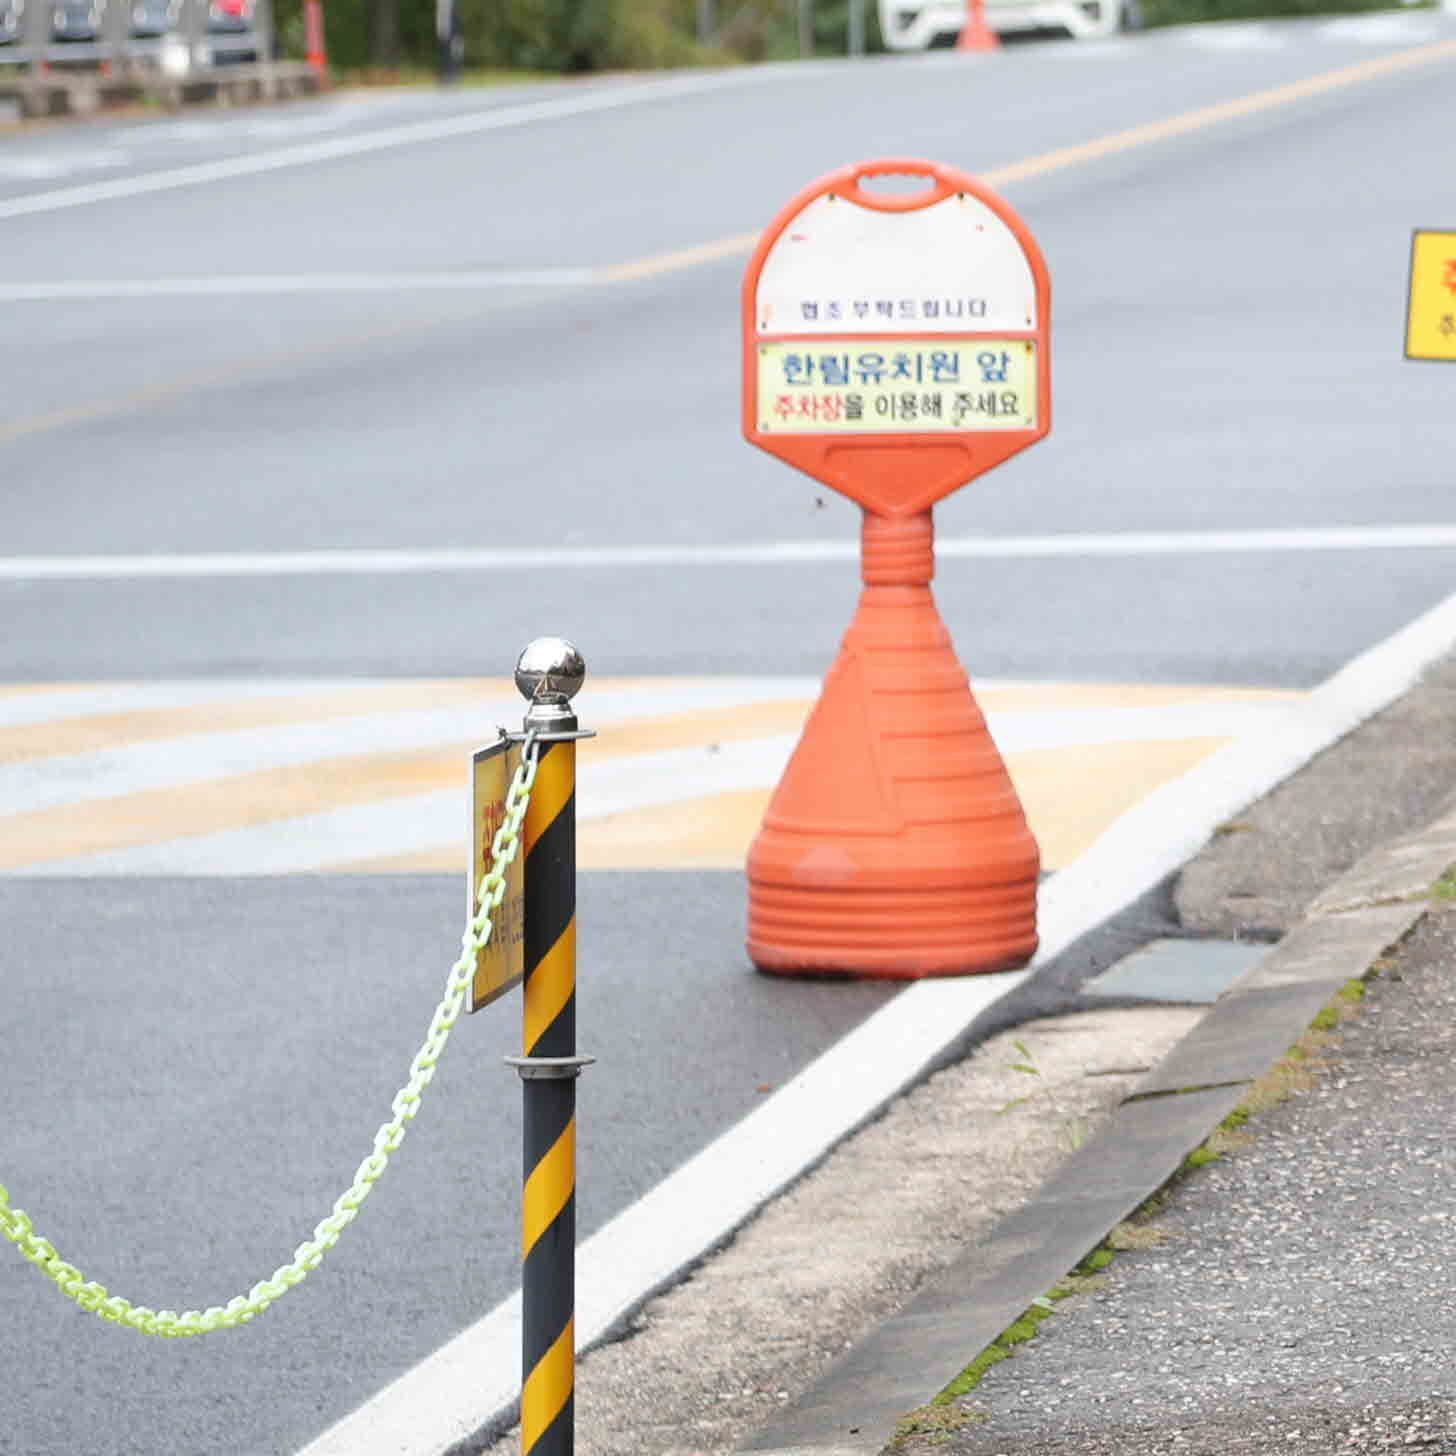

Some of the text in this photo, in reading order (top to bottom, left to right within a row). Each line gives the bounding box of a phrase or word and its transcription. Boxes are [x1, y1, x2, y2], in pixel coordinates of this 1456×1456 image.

[852, 299, 988, 320] 부탁드립니다
[782, 351, 1011, 386] 한림유치원 앞
[773, 391, 1020, 422] 주차장을 이용해 주세요
